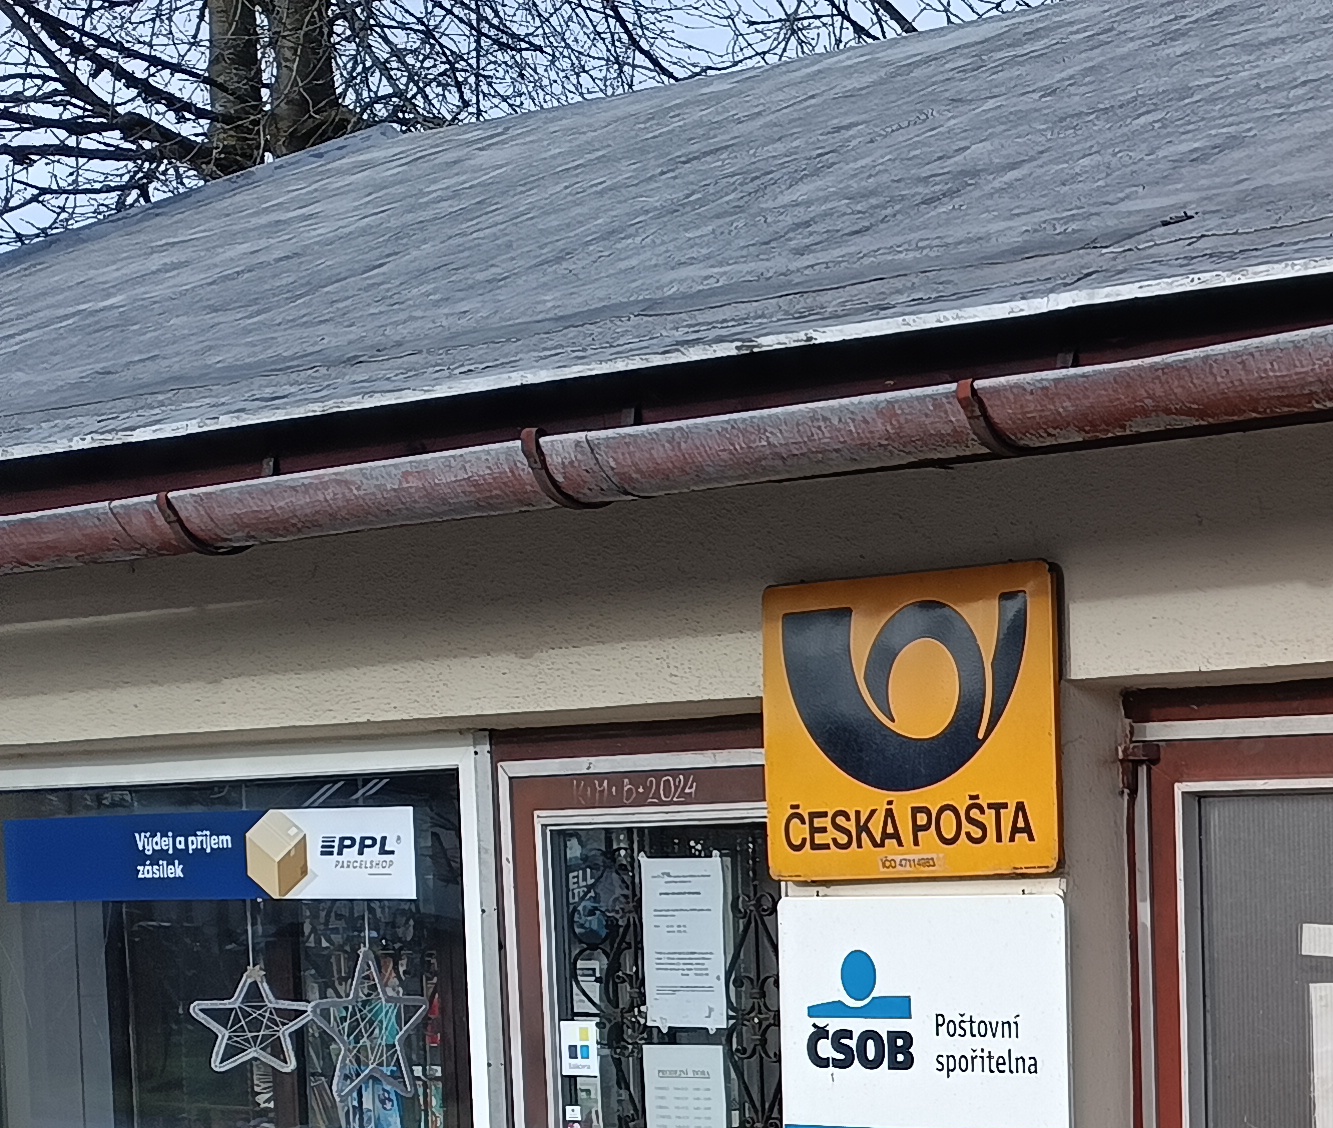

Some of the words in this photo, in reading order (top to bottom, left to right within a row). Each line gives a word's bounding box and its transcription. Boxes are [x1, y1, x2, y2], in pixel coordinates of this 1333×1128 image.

[784, 800, 904, 852] ČESKÁ
[911, 794, 1035, 847] POŠTA
[135, 831, 173, 854] Výdej
[176, 839, 185, 850] a
[188, 830, 232, 854] příjem
[137, 860, 184, 878] zásilek
[335, 860, 394, 869] PARCELSHOP
[935, 1013, 1020, 1038] Poštovní
[806, 1022, 914, 1070] ČSOB
[935, 1047, 1038, 1078] spořitelna
